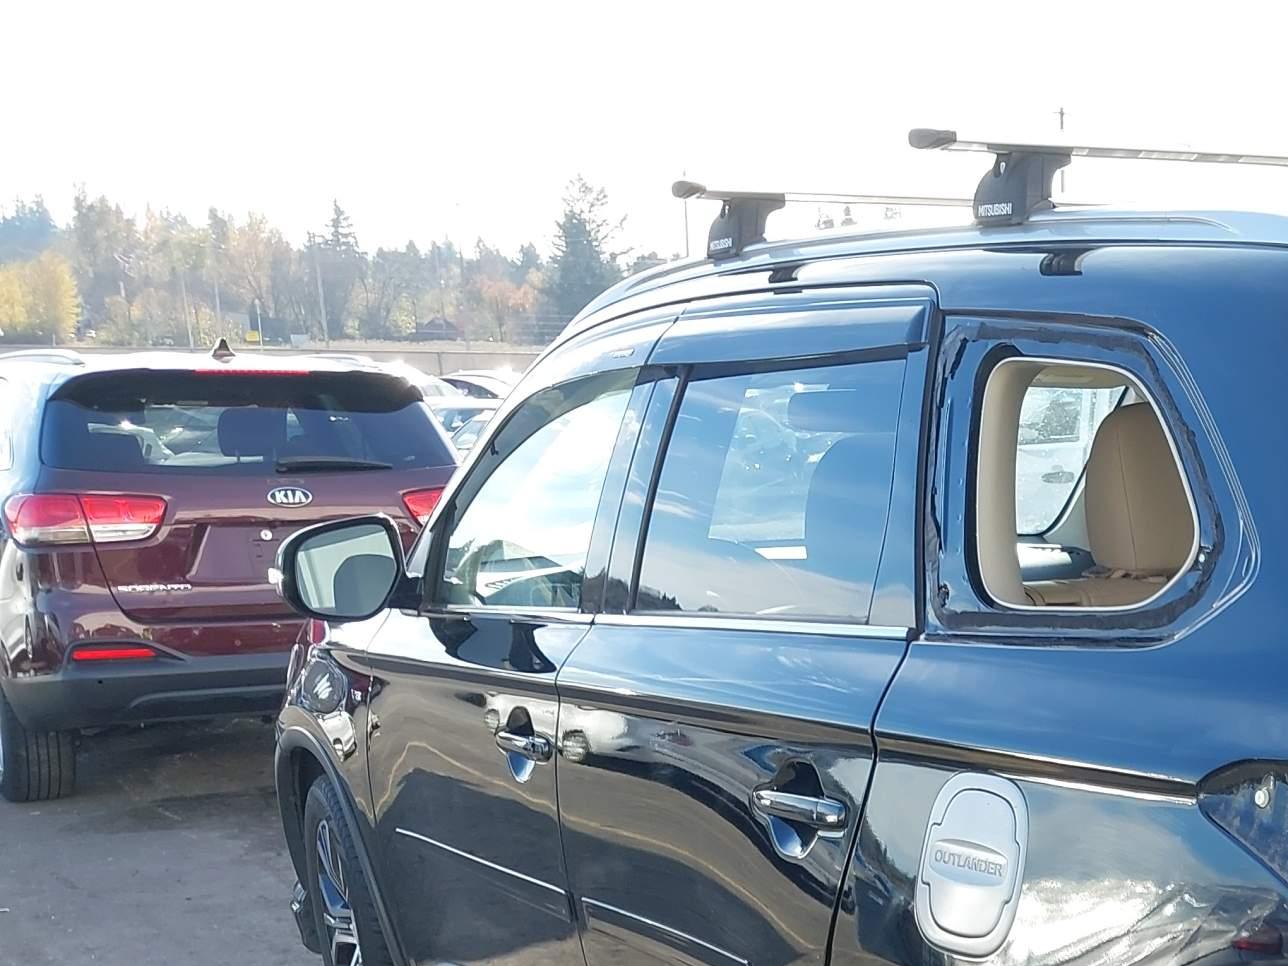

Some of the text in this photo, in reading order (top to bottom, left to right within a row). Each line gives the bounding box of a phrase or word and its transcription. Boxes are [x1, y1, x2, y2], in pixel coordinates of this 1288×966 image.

[978, 202, 1012, 217] MITSUBISHI
[274, 489, 307, 504] KIA
[935, 849, 1003, 877] OUTLANDER
